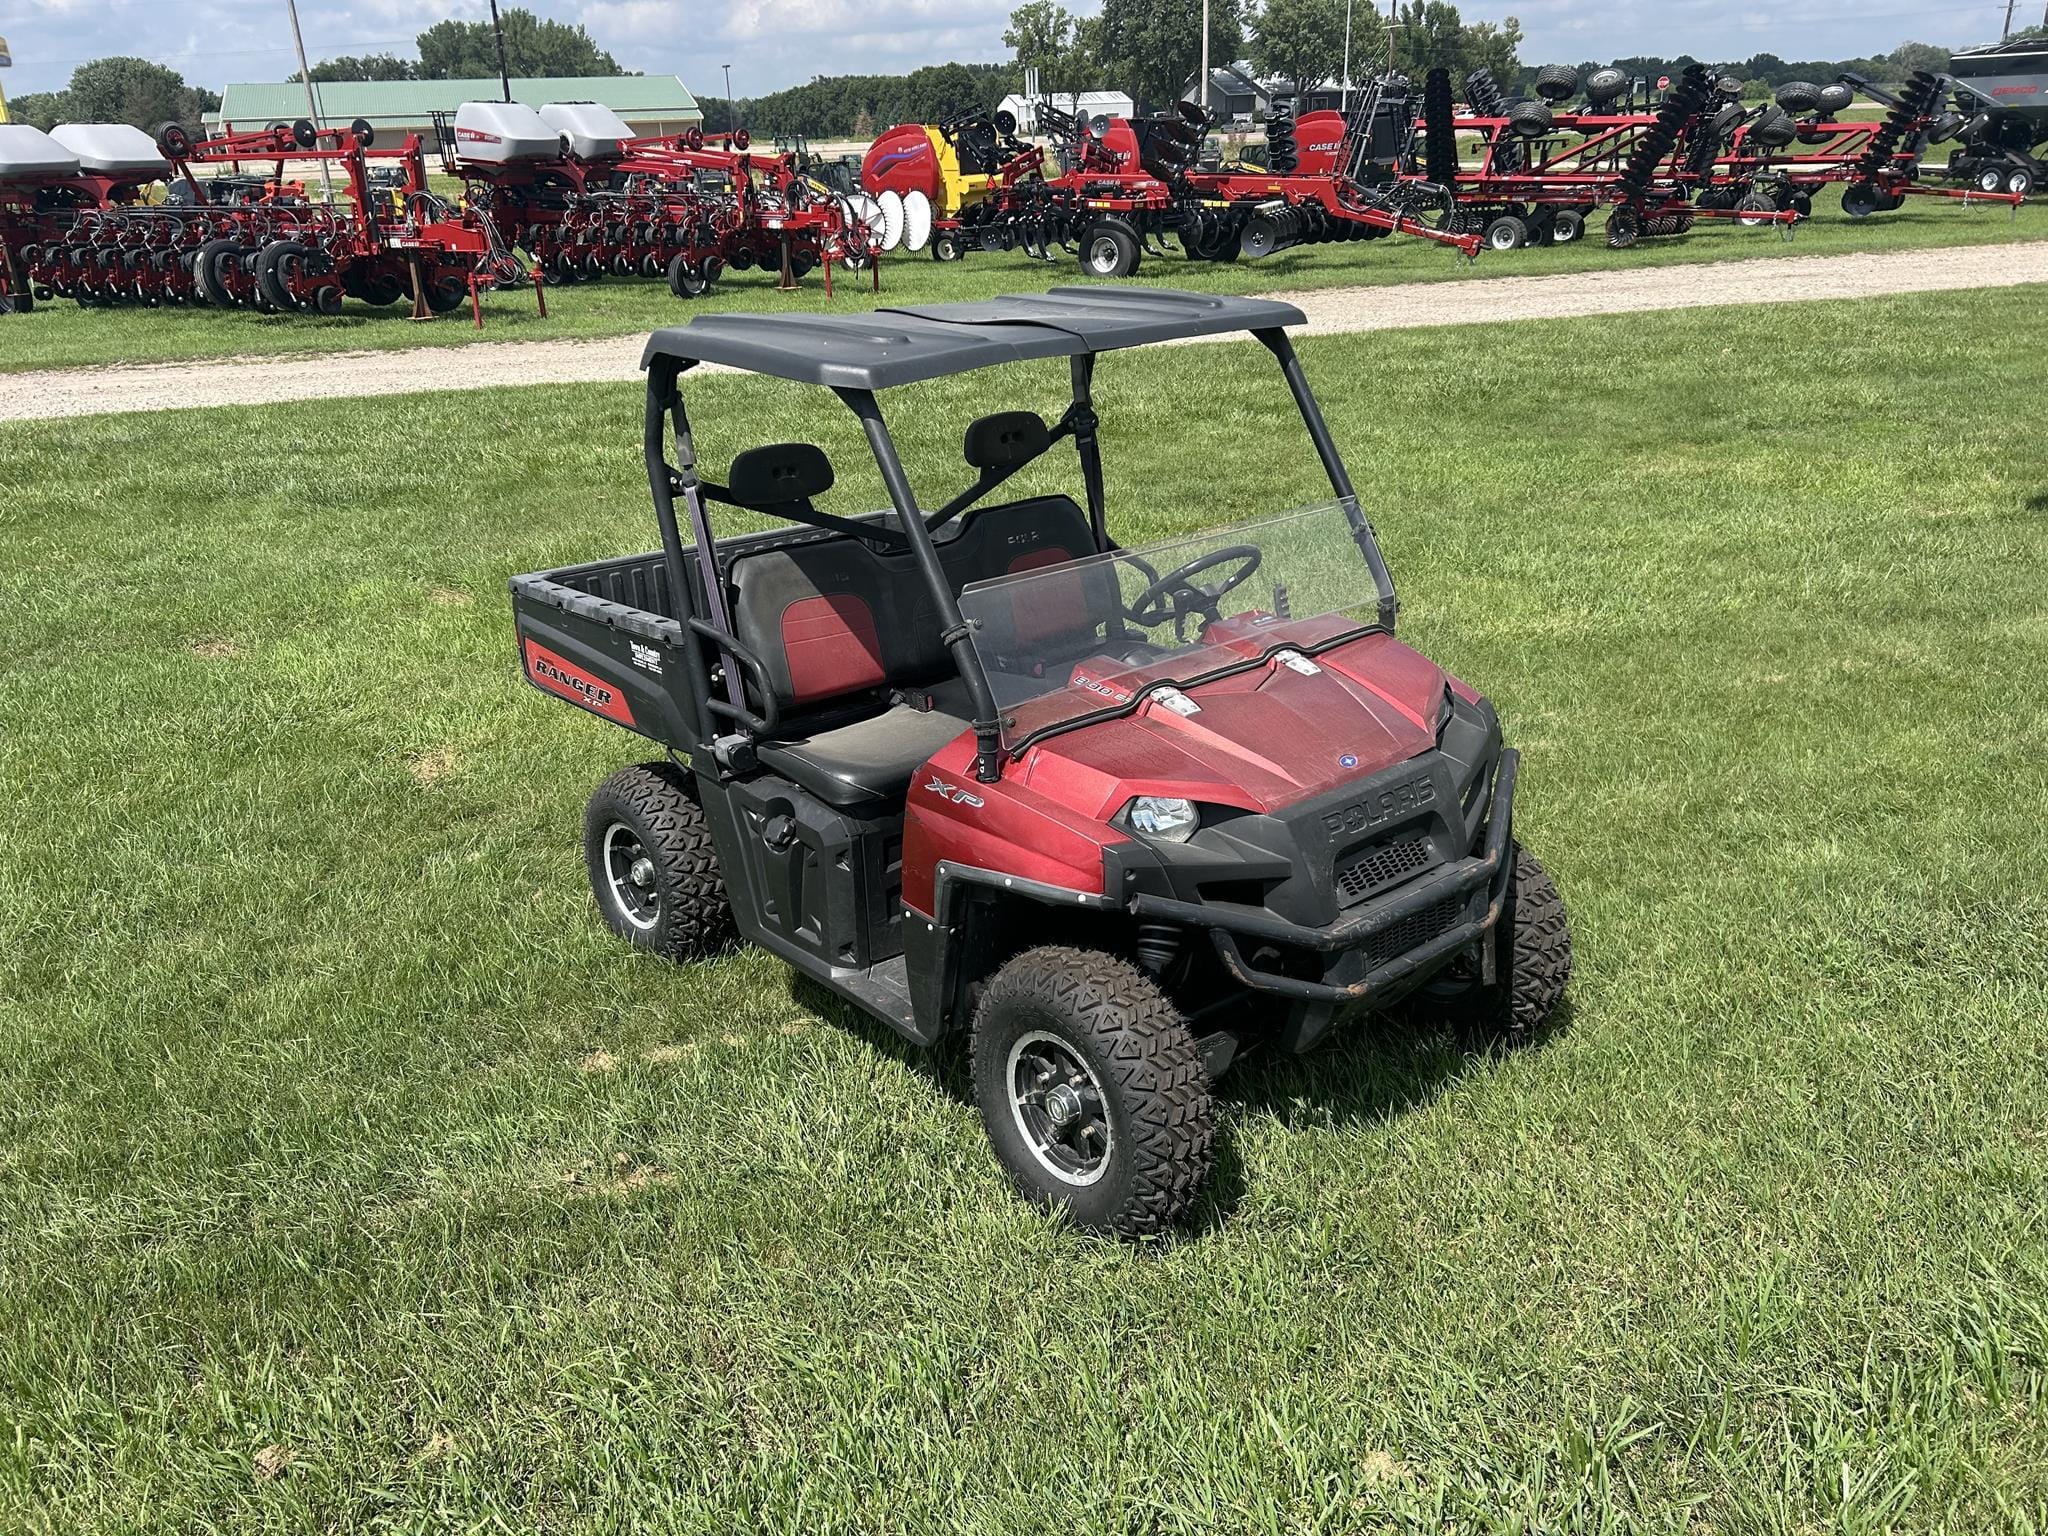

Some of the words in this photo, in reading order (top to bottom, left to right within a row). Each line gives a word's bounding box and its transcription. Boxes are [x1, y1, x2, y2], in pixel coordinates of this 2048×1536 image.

[1309, 143, 1334, 151] CASE
[535, 659, 613, 704] RANGER
[1074, 676, 1114, 697] 800
[583, 696, 603, 707] XP
[924, 775, 985, 808] XP
[1320, 775, 1436, 843] POLARIS
